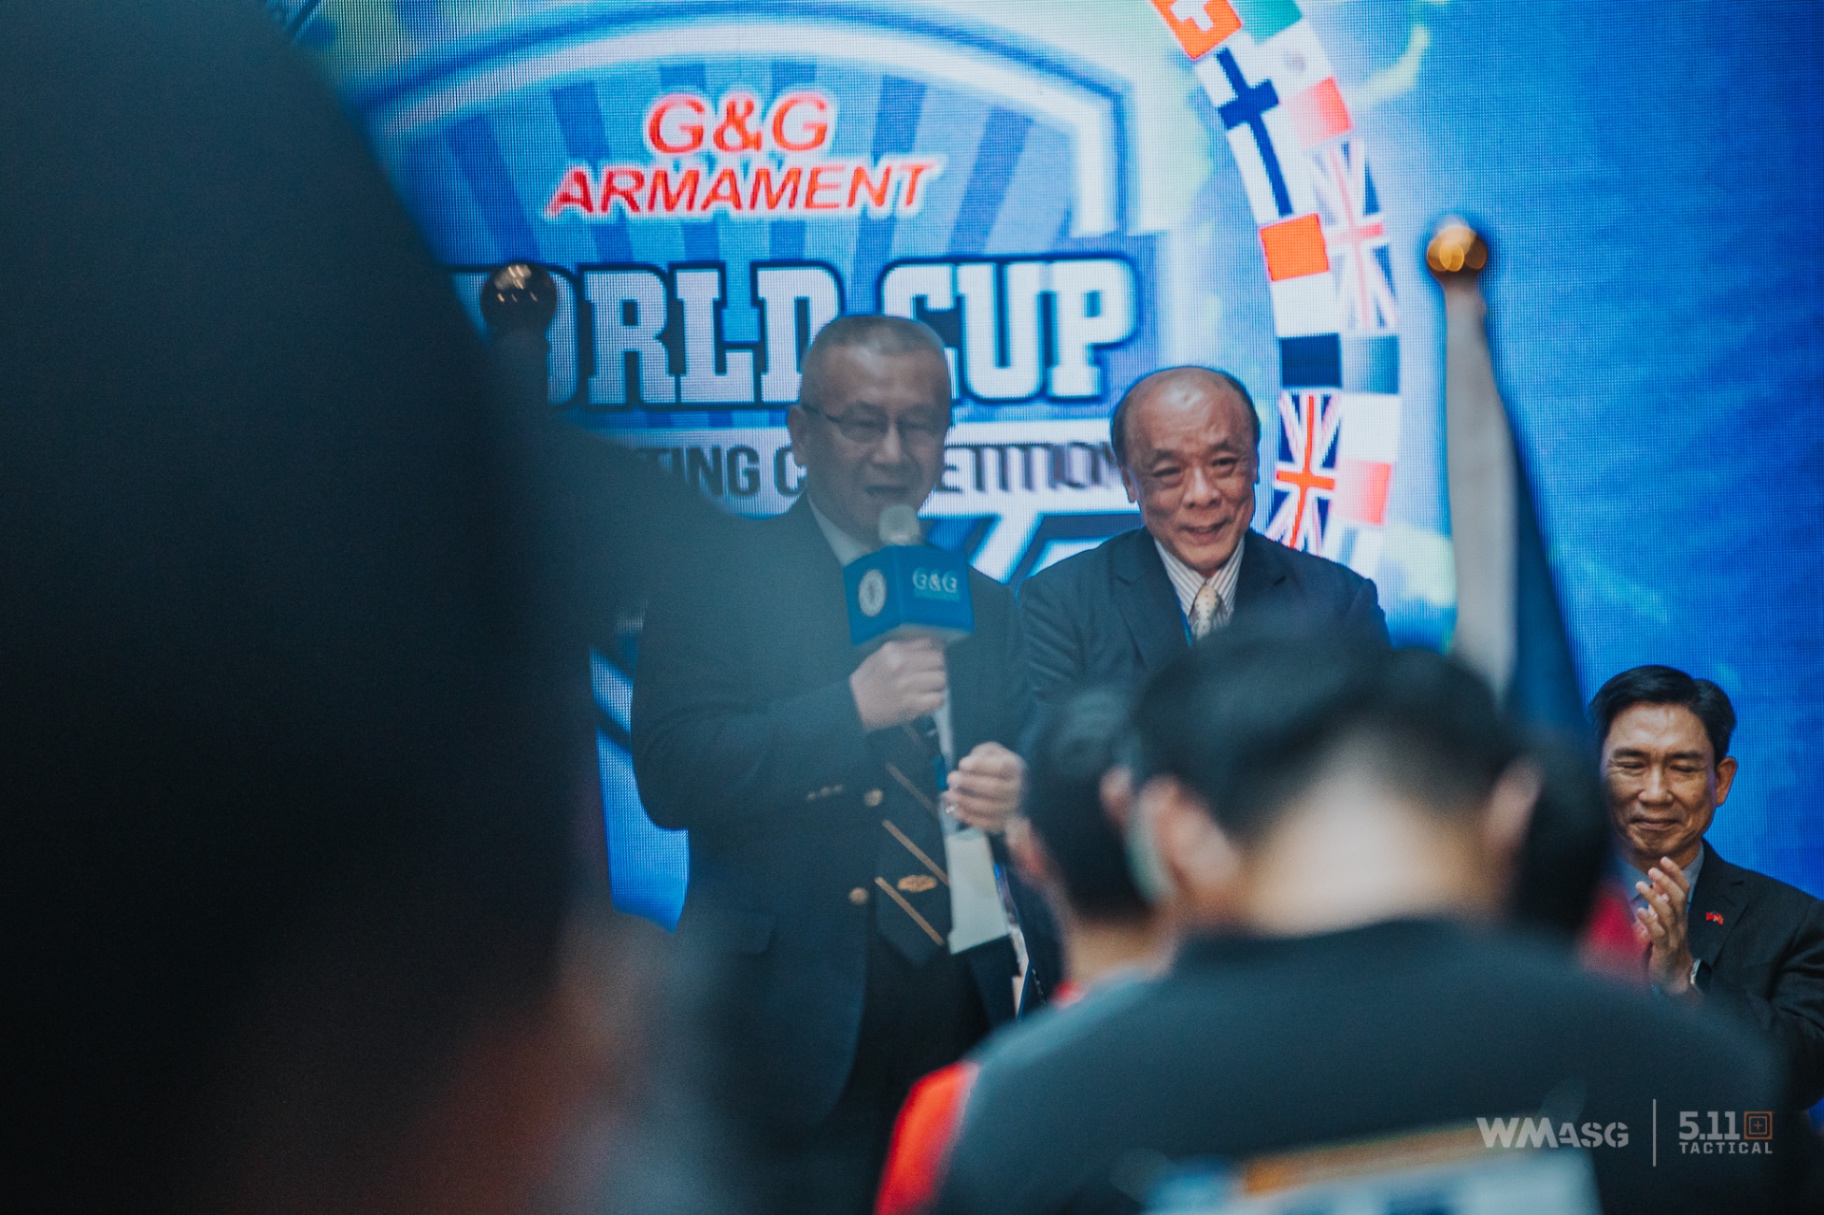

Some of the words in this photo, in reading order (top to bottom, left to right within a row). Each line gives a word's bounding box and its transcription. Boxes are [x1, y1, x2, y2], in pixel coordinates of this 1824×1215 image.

[647, 91, 829, 154] G&G
[546, 162, 937, 216] ARMAMENT
[912, 569, 958, 593] G&G
